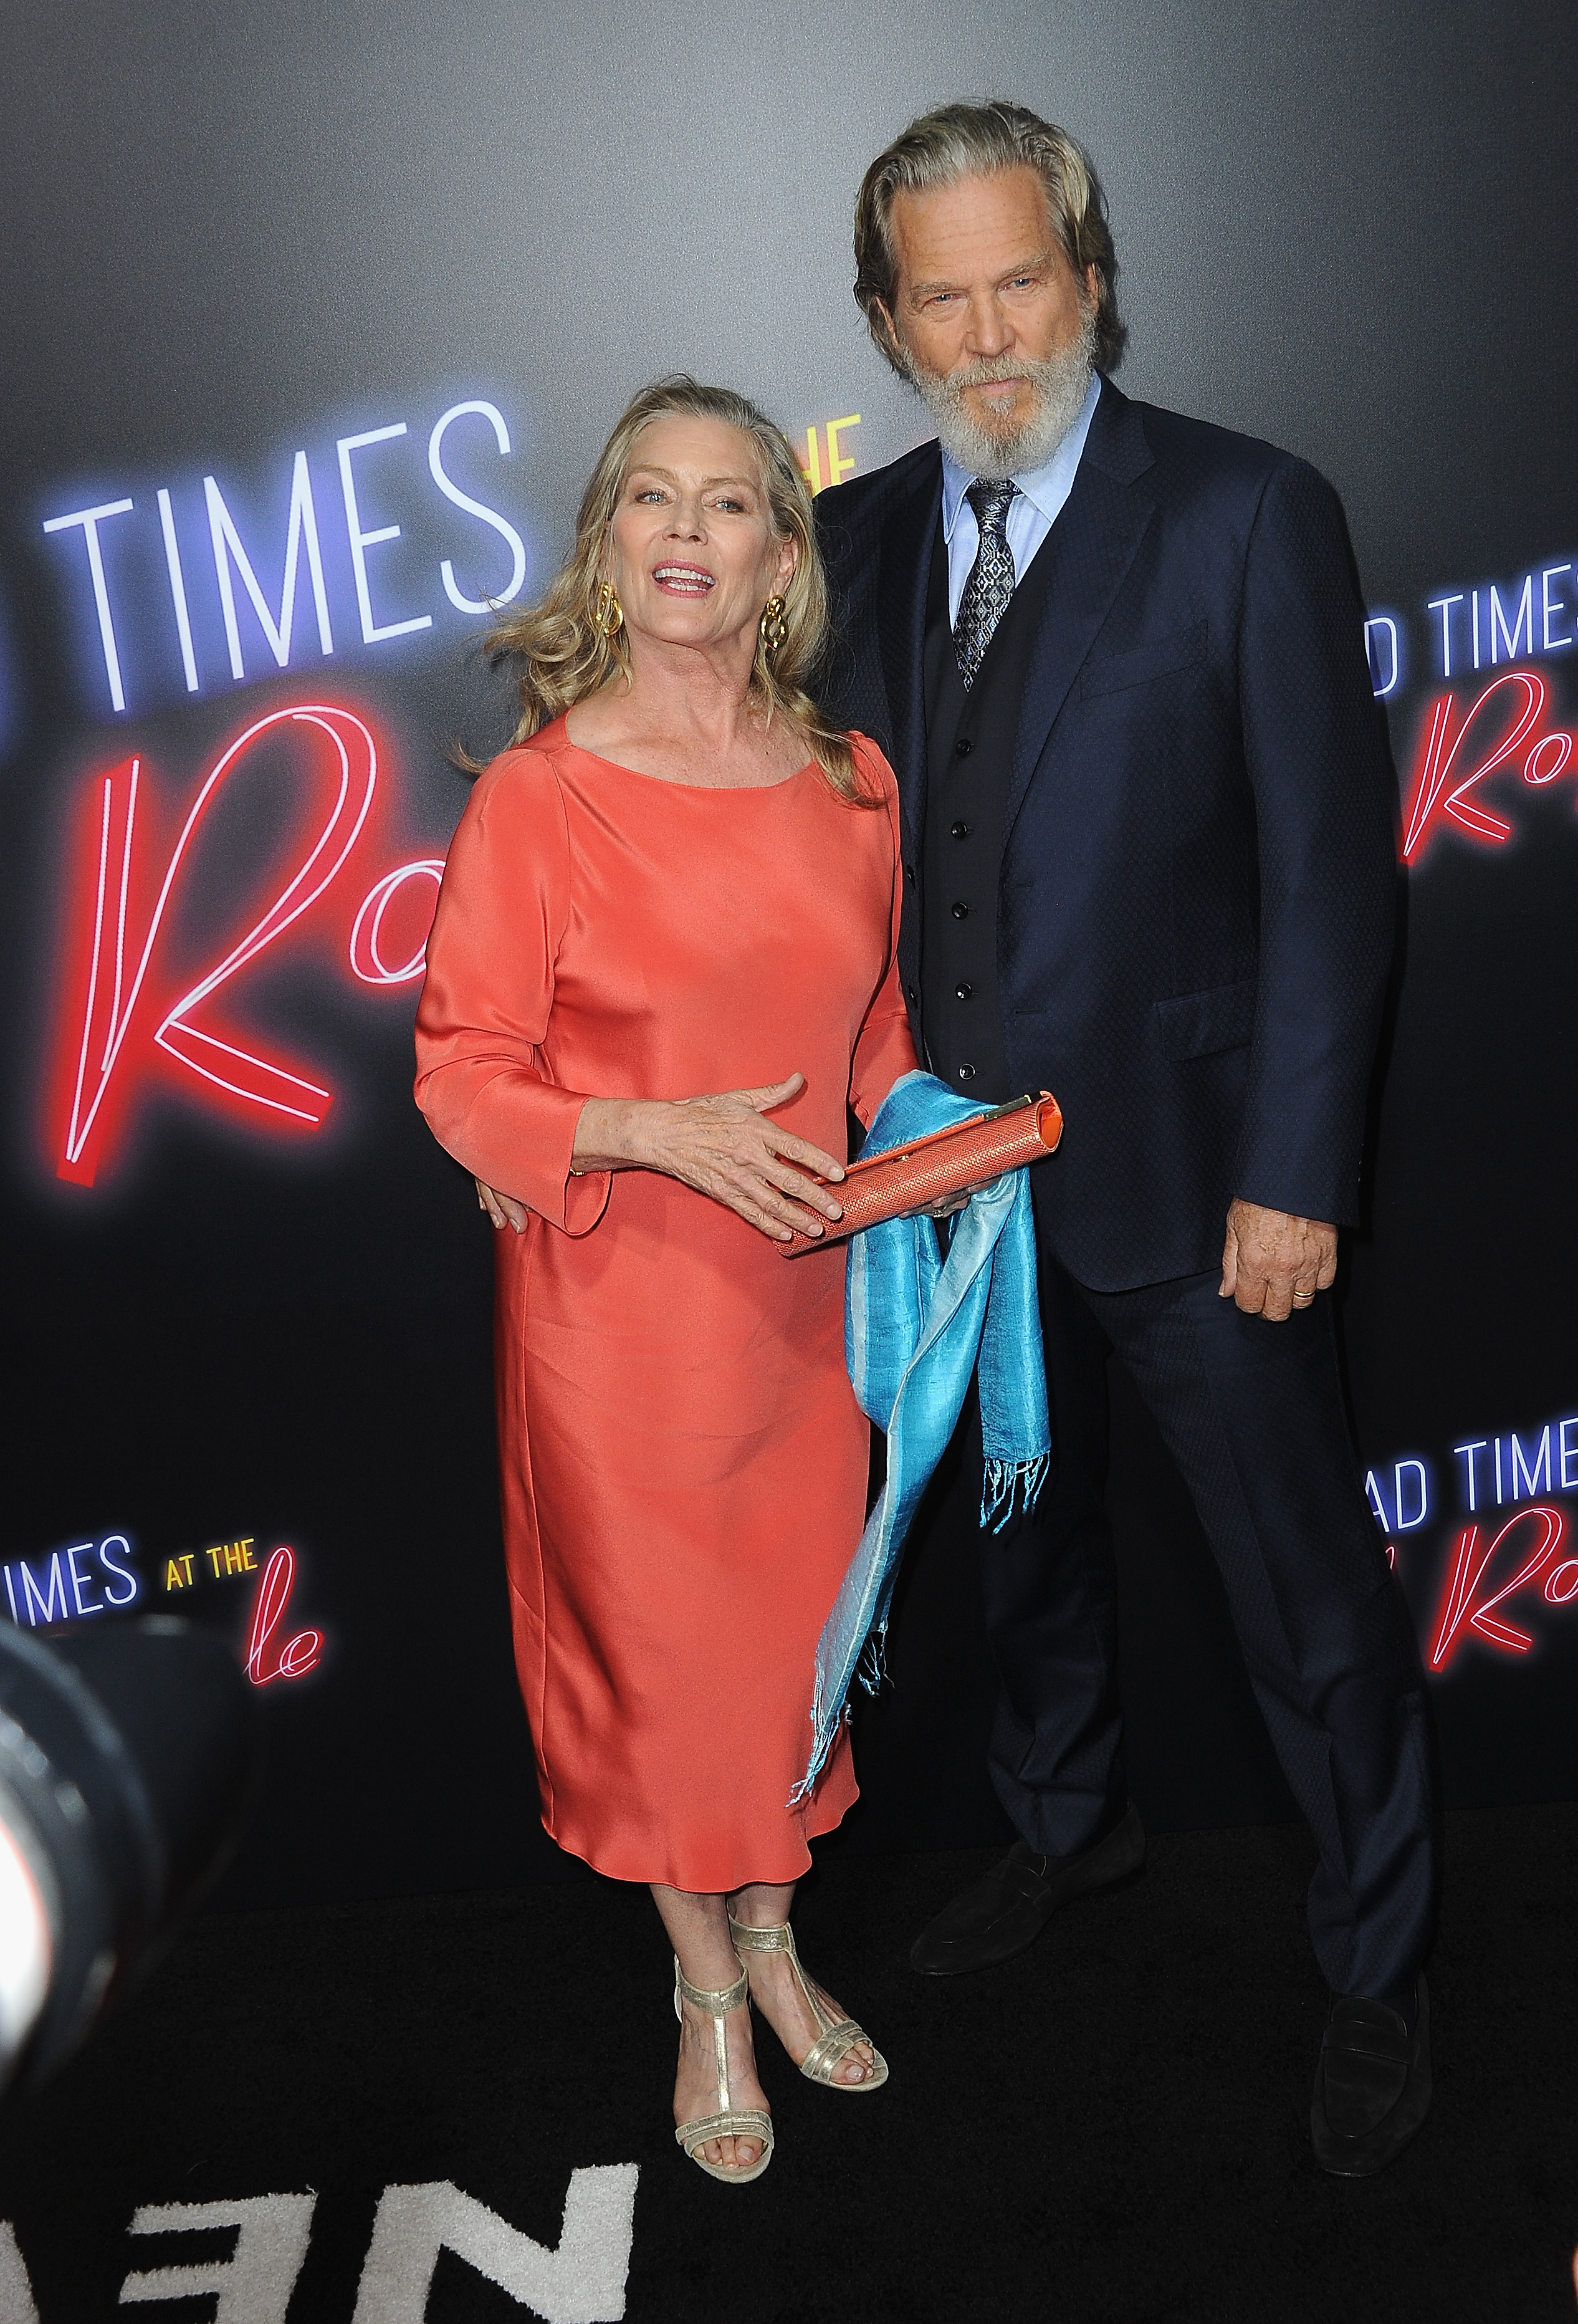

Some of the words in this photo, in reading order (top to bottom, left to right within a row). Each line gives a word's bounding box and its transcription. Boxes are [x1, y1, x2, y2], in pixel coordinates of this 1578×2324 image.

[44, 400, 526, 712] TIMES
[783, 413, 862, 499] HE
[1428, 564, 1578, 676] TIME
[1454, 1417, 1578, 1512] TIME
[3, 1535, 137, 1626] IMES
[166, 1554, 194, 1591] AT
[206, 1537, 258, 1578] THE
[0, 2163, 639, 2324] NE
